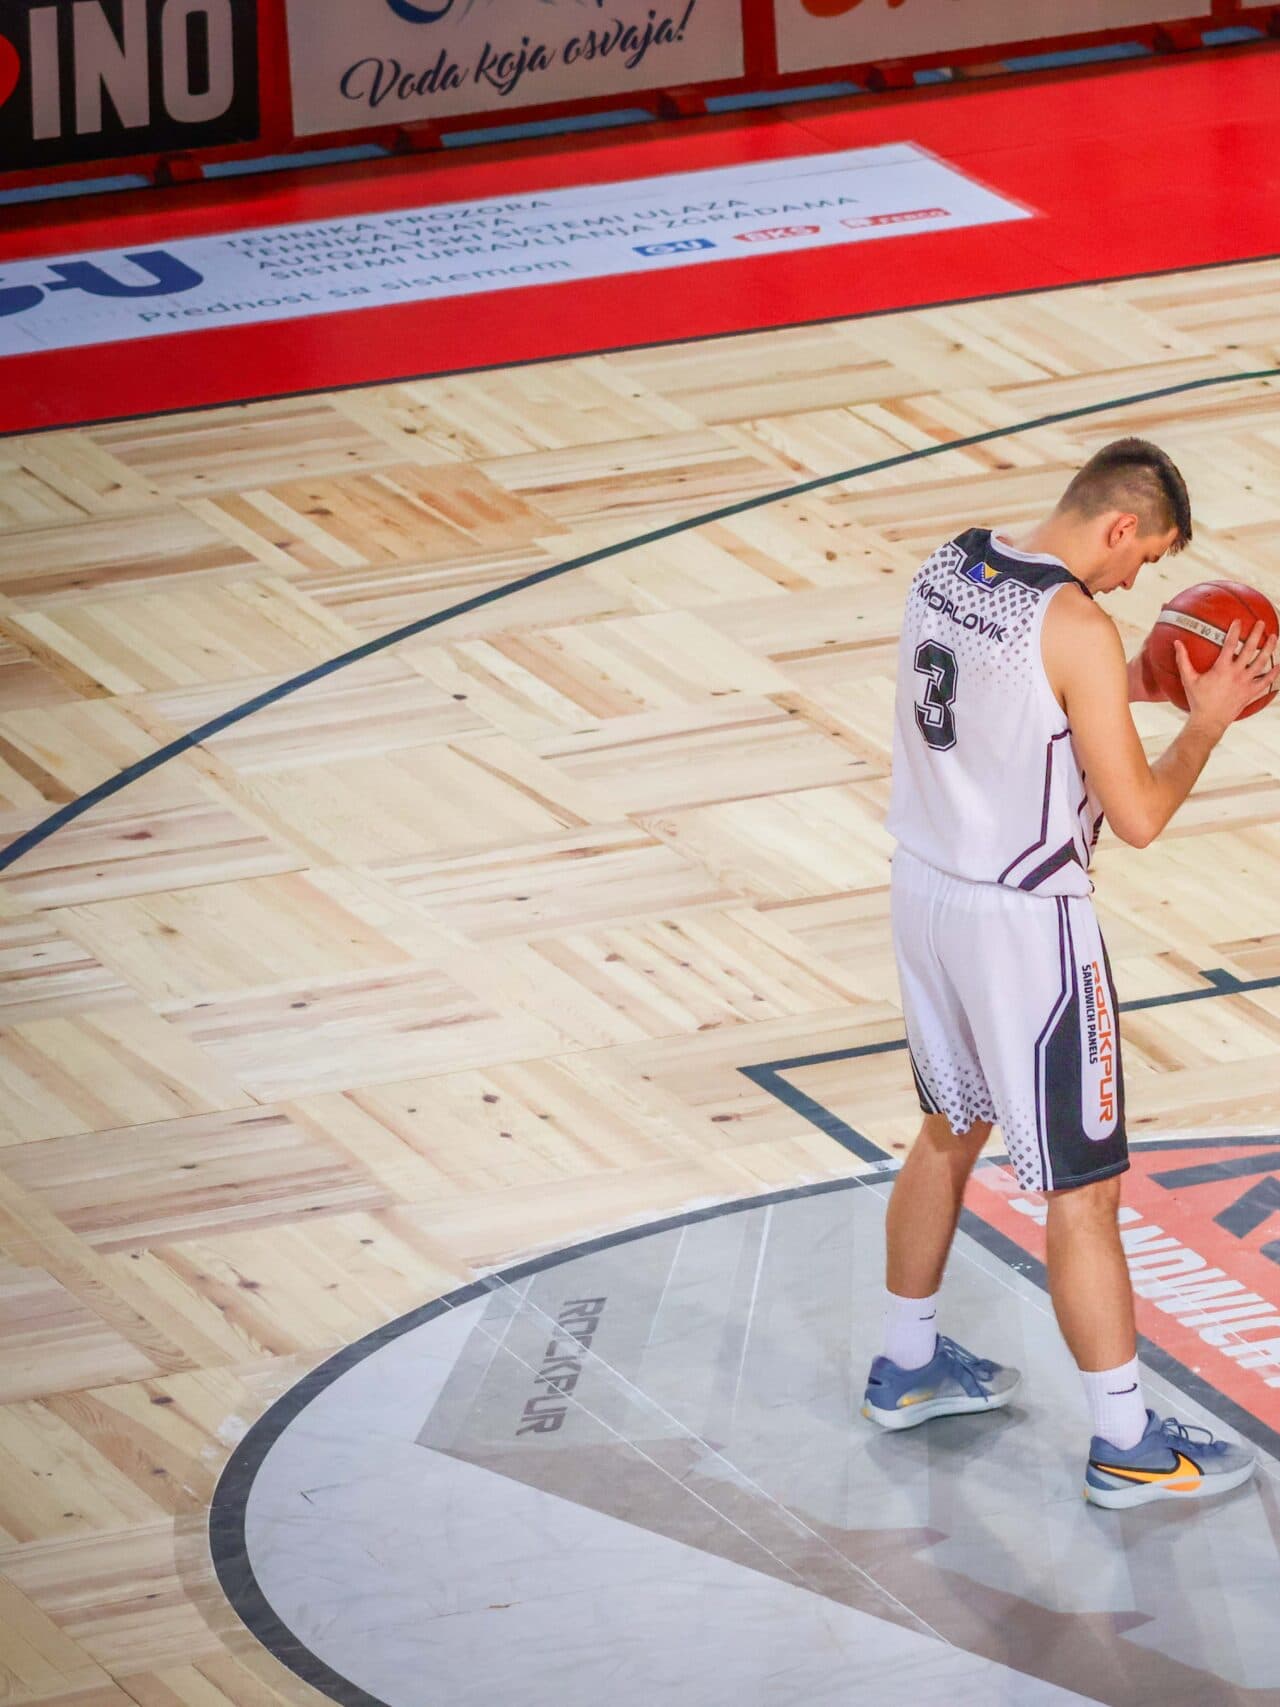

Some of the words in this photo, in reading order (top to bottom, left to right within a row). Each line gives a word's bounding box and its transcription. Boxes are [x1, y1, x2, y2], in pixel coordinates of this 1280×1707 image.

[341, 49, 469, 108] Voda
[474, 37, 556, 95] koja
[563, 0, 698, 70] osvaja!
[222, 222, 376, 248] TEHNIKA
[384, 200, 552, 226] PROZORA
[241, 232, 394, 259] TEHNIKA
[400, 217, 515, 236] VRATA
[259, 233, 482, 270] AUTOMATSKI
[492, 215, 624, 239] SISTEMI
[632, 200, 749, 219] ULAZA
[271, 256, 406, 280] SISTEMI
[416, 224, 655, 260] UPRAVLJANJA
[661, 197, 860, 229] ZGRADAMA
[137, 292, 320, 323] Prednost
[328, 285, 371, 298] sa
[381, 260, 572, 290] sistemom
[914, 638, 958, 752] 3
[1081, 963, 1096, 1022] SANDWICH
[1087, 1023, 1099, 1065] PANELS
